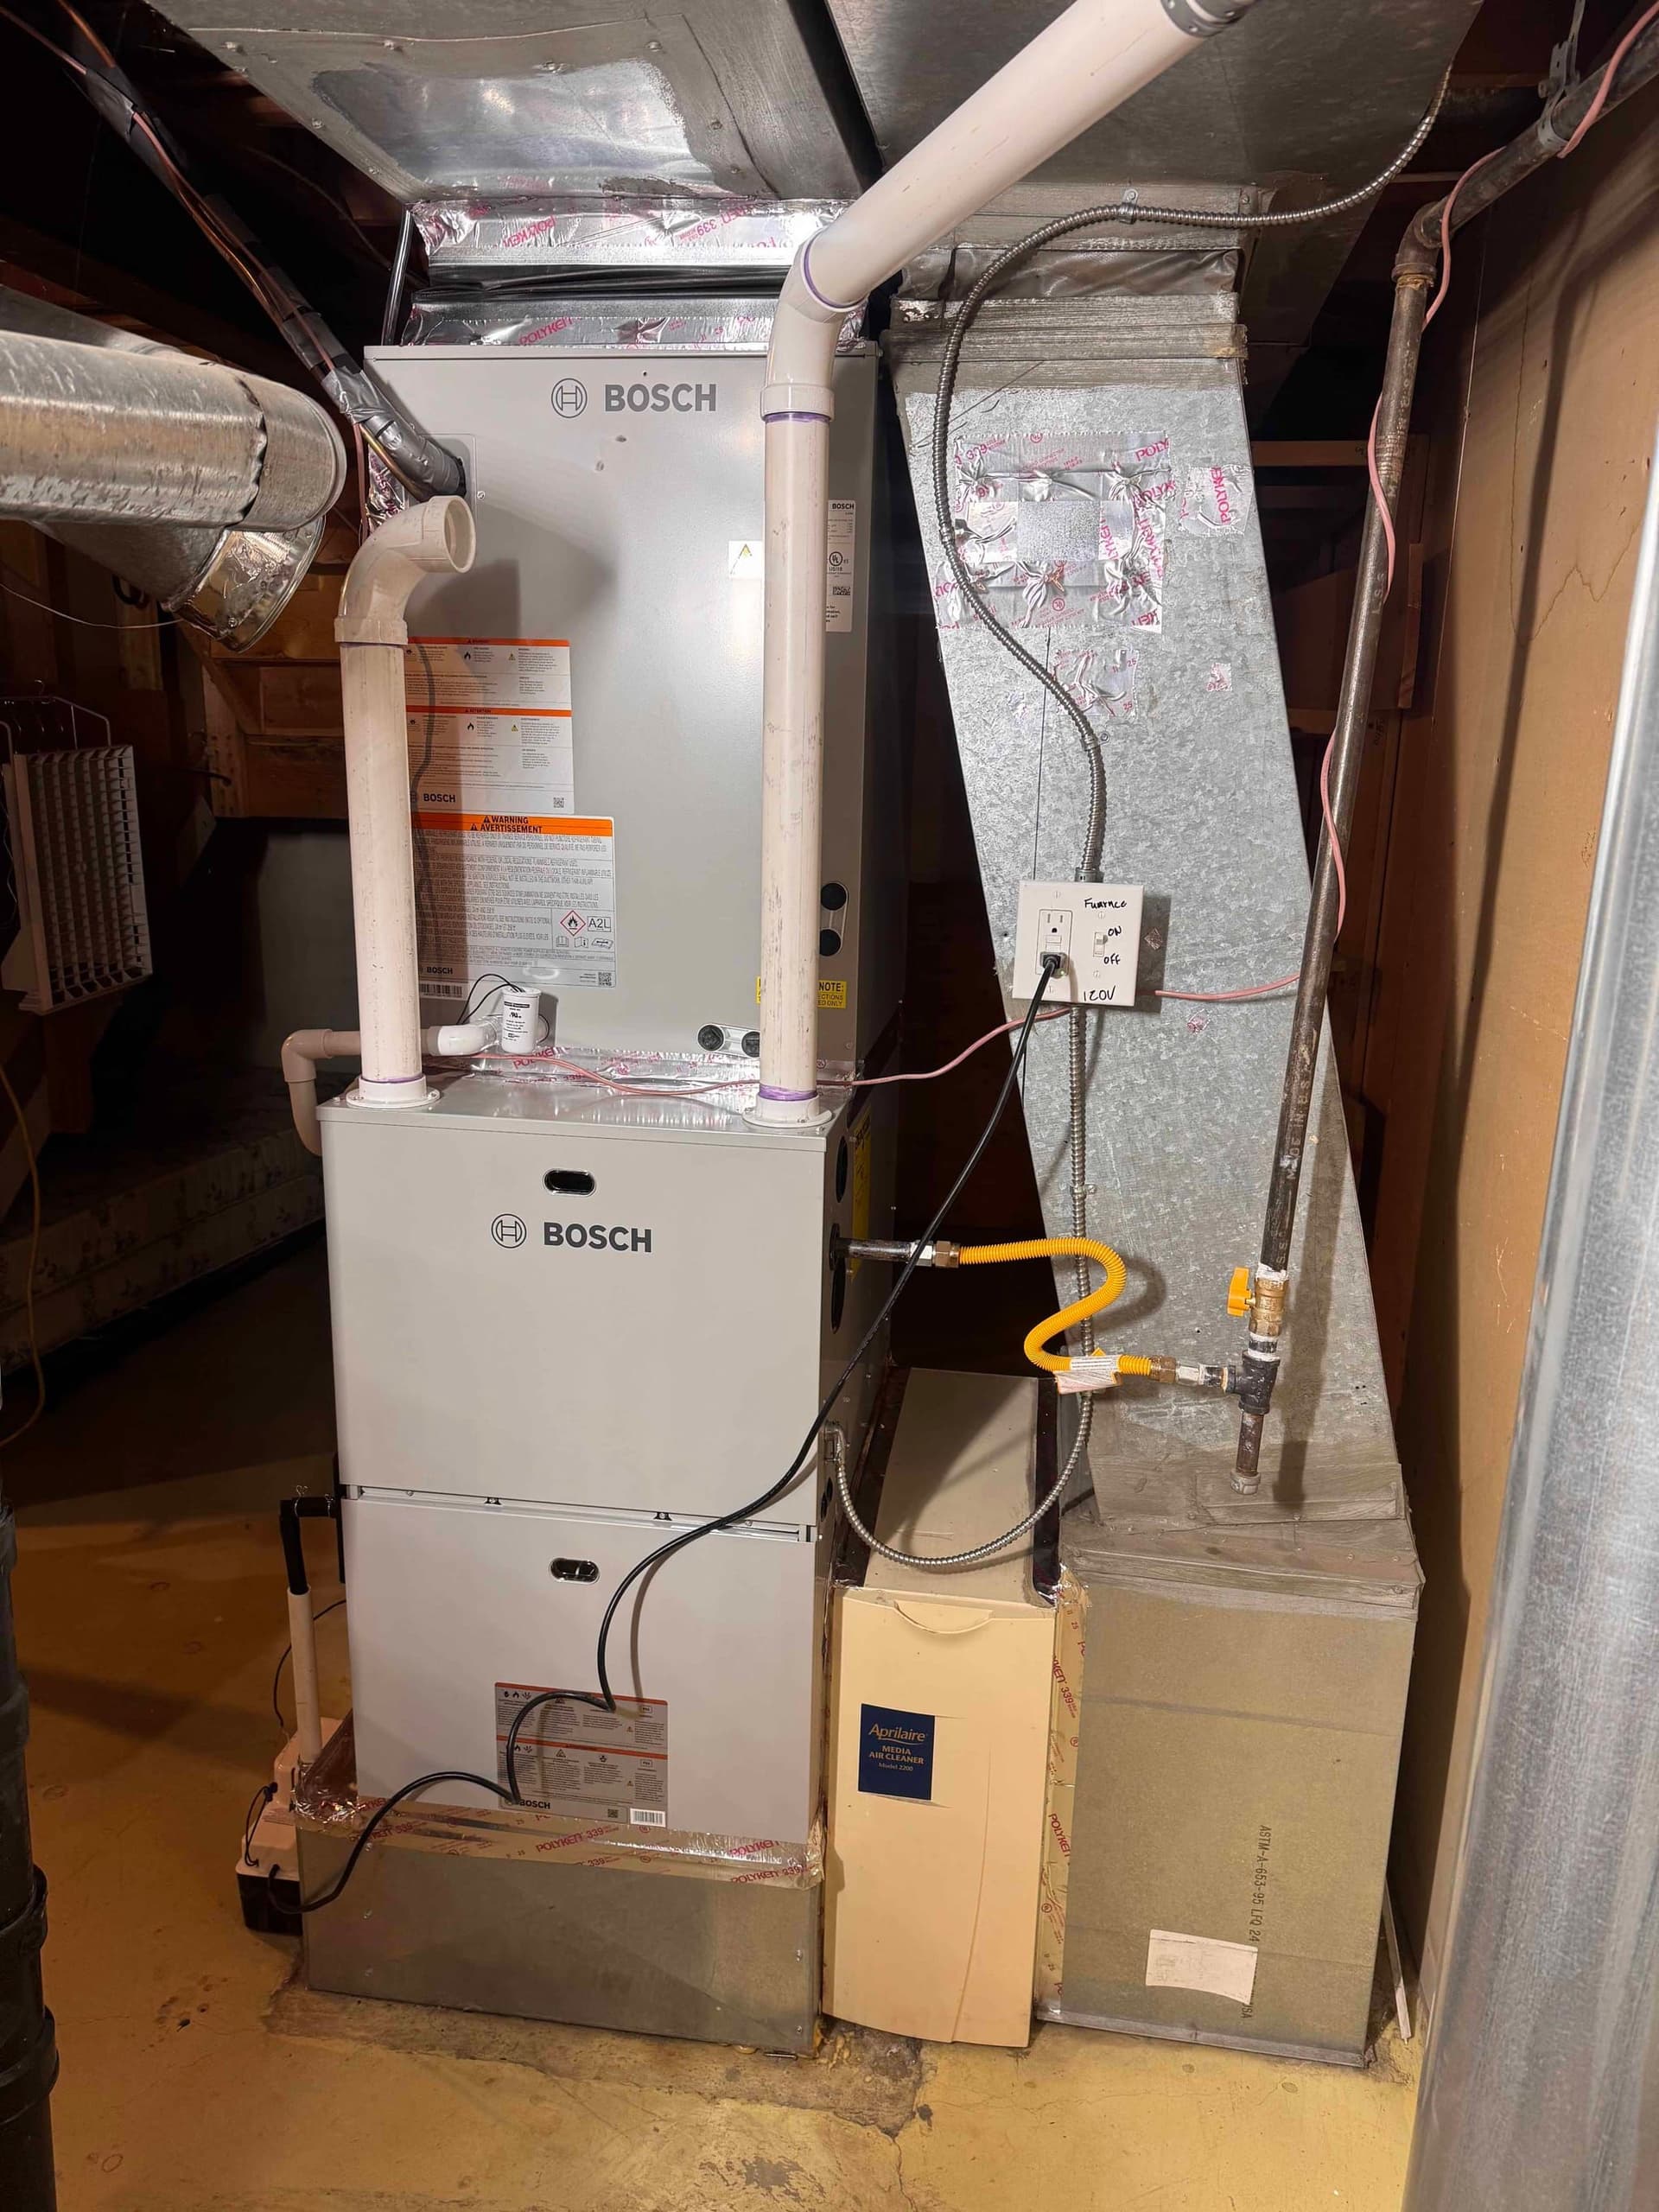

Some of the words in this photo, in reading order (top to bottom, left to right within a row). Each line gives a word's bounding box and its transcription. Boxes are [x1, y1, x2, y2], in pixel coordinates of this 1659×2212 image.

[605, 383, 717, 412] BOSCH
[1135, 438, 1170, 461] POLY
[423, 793, 456, 803] BOSCH
[491, 815, 529, 824] WARNING
[480, 823, 543, 834] AVERTISSEMENT
[588, 918, 611, 929] A2L
[427, 966, 454, 975] BOSCH
[819, 982, 844, 992] NOTE:
[1084, 985, 1116, 1001] 120V
[543, 1222, 652, 1253] BOSCH
[1060, 1687, 1073, 1704] 339
[868, 1723, 925, 1742] Aprilaire
[882, 1745, 912, 1755] MEDIA
[885, 1754, 925, 1764] CLEANER
[520, 1799, 550, 1809] BOSCH
[536, 1834, 583, 1852] POLYKEN
[586, 1827, 604, 1840] 339
[1253, 1825, 1272, 1905] ASTM-A-653-95
[1249, 1907, 1263, 1927] LFQ
[1249, 1929, 1262, 1942] 24
